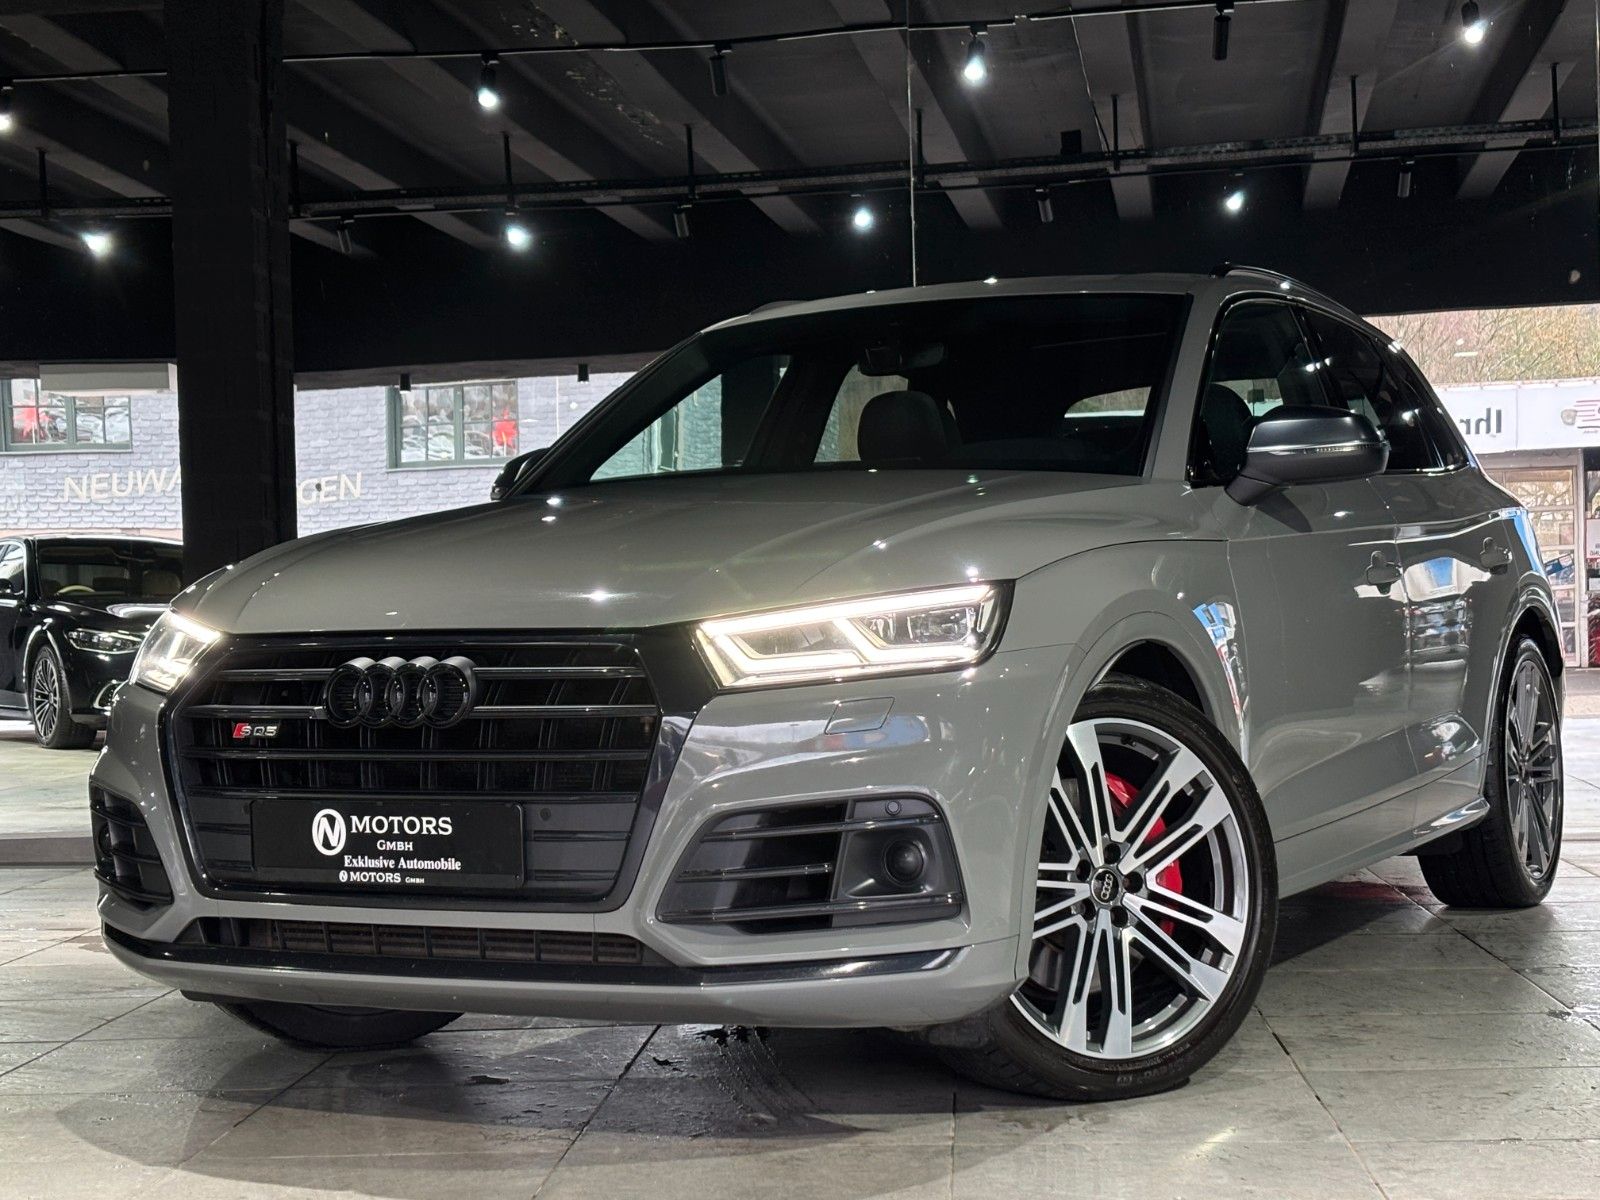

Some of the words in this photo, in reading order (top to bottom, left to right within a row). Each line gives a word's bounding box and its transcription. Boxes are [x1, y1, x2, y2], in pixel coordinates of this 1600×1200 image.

[239, 725, 278, 737] SQ5
[350, 815, 453, 835] MOTORS
[344, 854, 395, 869] Exklusive
[398, 856, 462, 871] Automobile
[350, 871, 402, 884] MOTORS
